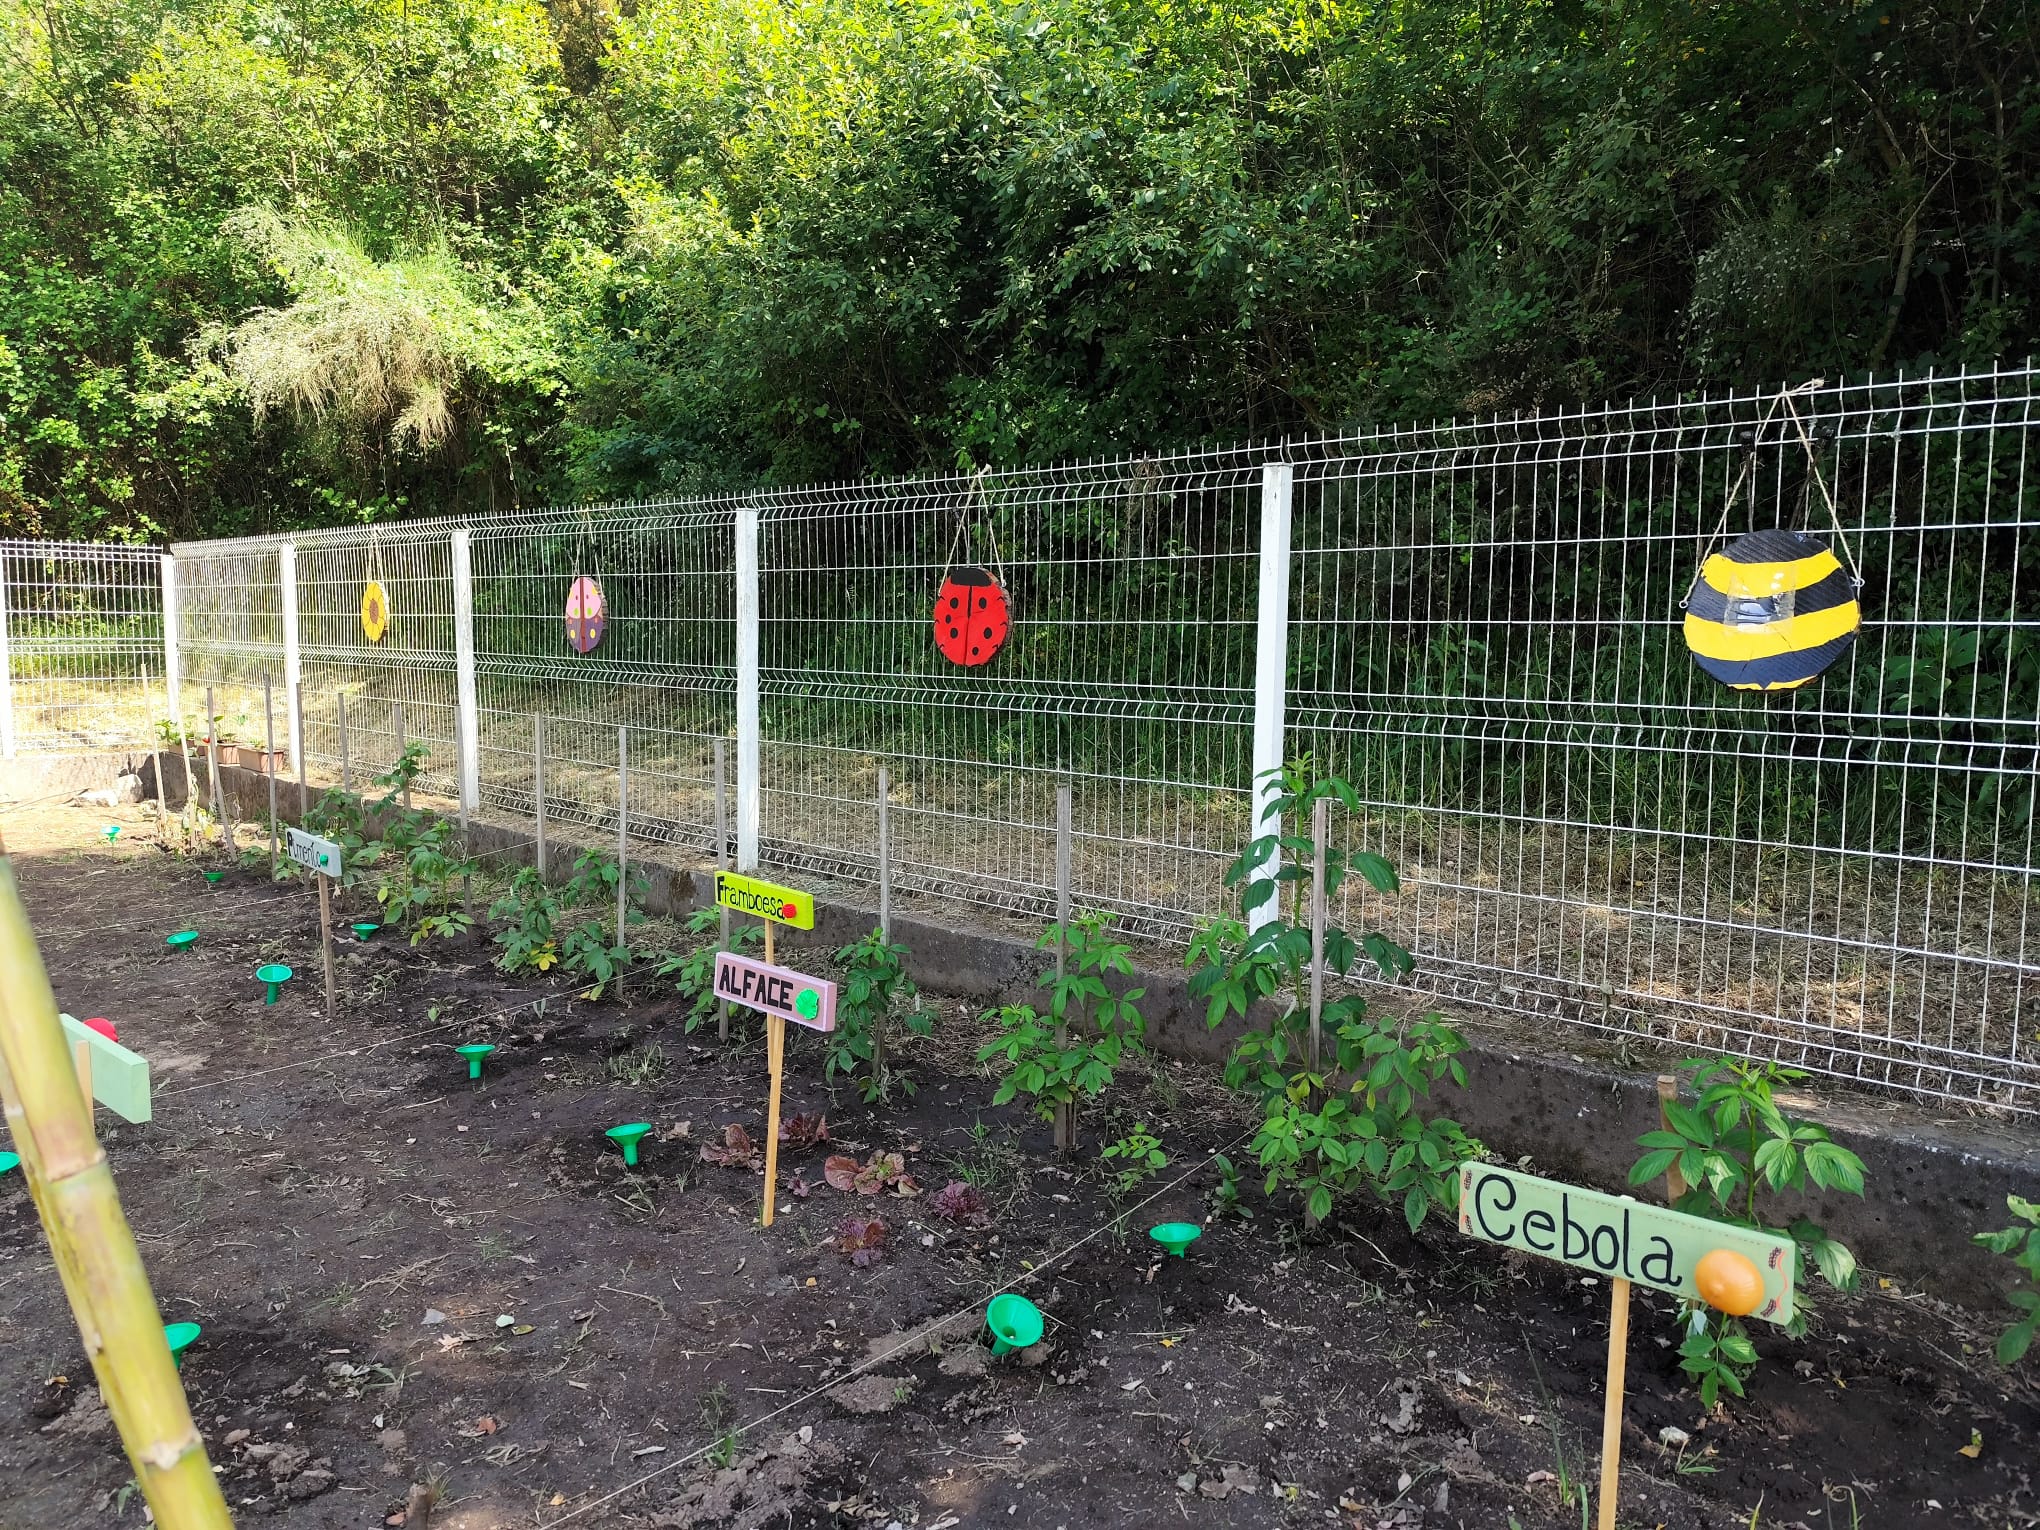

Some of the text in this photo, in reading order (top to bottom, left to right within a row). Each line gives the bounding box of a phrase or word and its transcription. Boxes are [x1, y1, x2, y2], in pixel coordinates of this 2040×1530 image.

[717, 876, 785, 920] Framboesa
[719, 964, 794, 1011] ALFACE
[1475, 1174, 1682, 1286] Cebola
